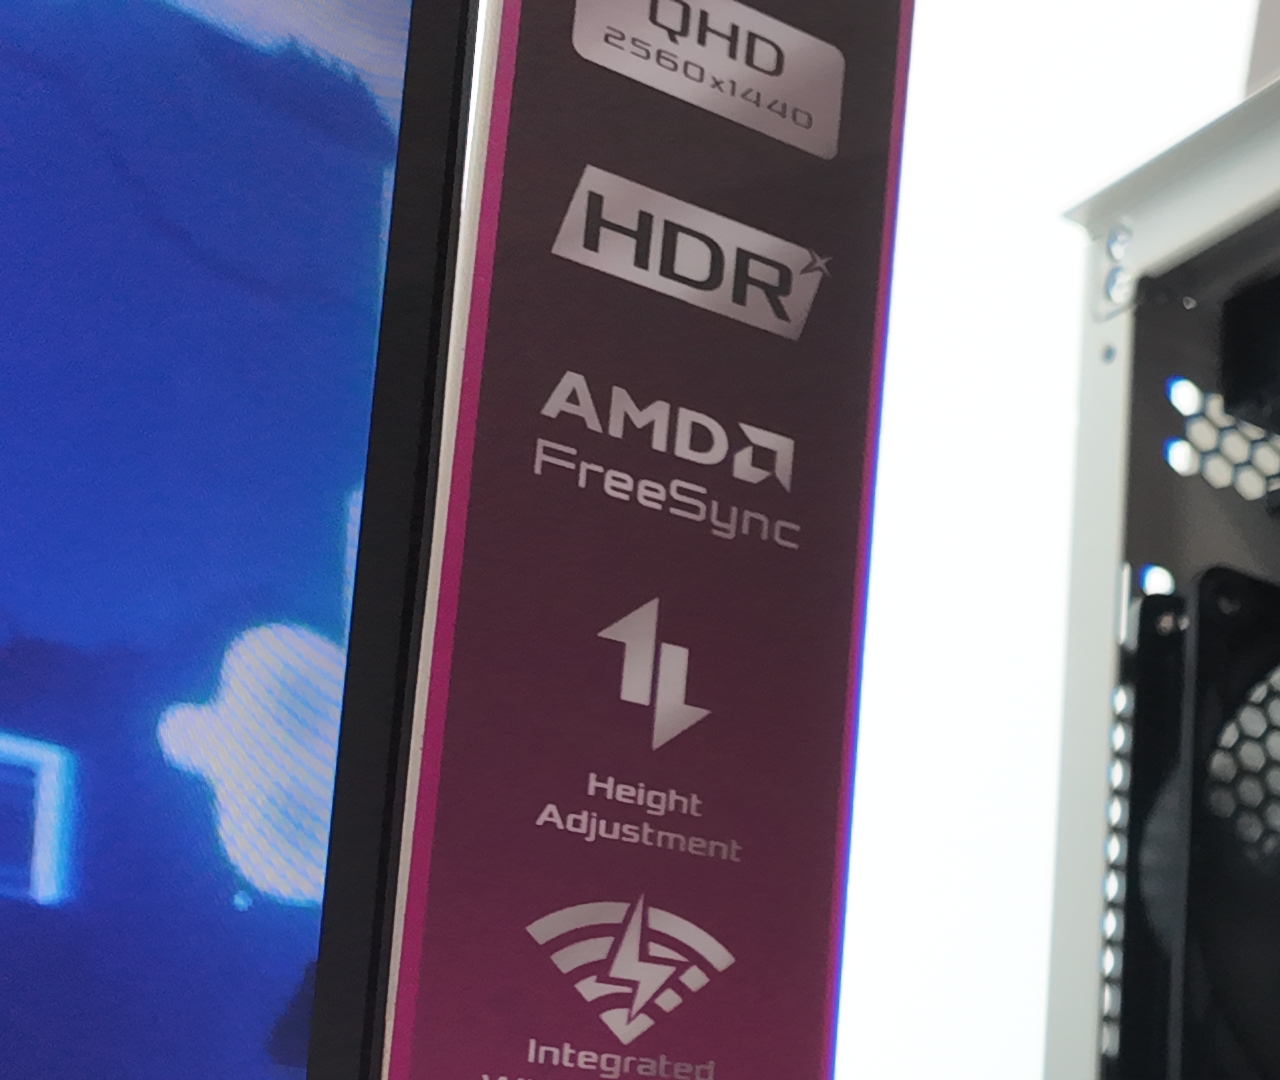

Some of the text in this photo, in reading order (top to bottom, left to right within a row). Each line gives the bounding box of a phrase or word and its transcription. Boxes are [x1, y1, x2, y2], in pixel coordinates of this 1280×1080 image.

[603, 27, 814, 131] 2560x1440
[648, 0, 785, 77] QHD
[582, 190, 791, 323] HDR
[540, 370, 730, 466] AMD
[533, 437, 801, 549] FreeSync
[535, 803, 743, 863] Adjustment
[587, 772, 703, 818] Height
